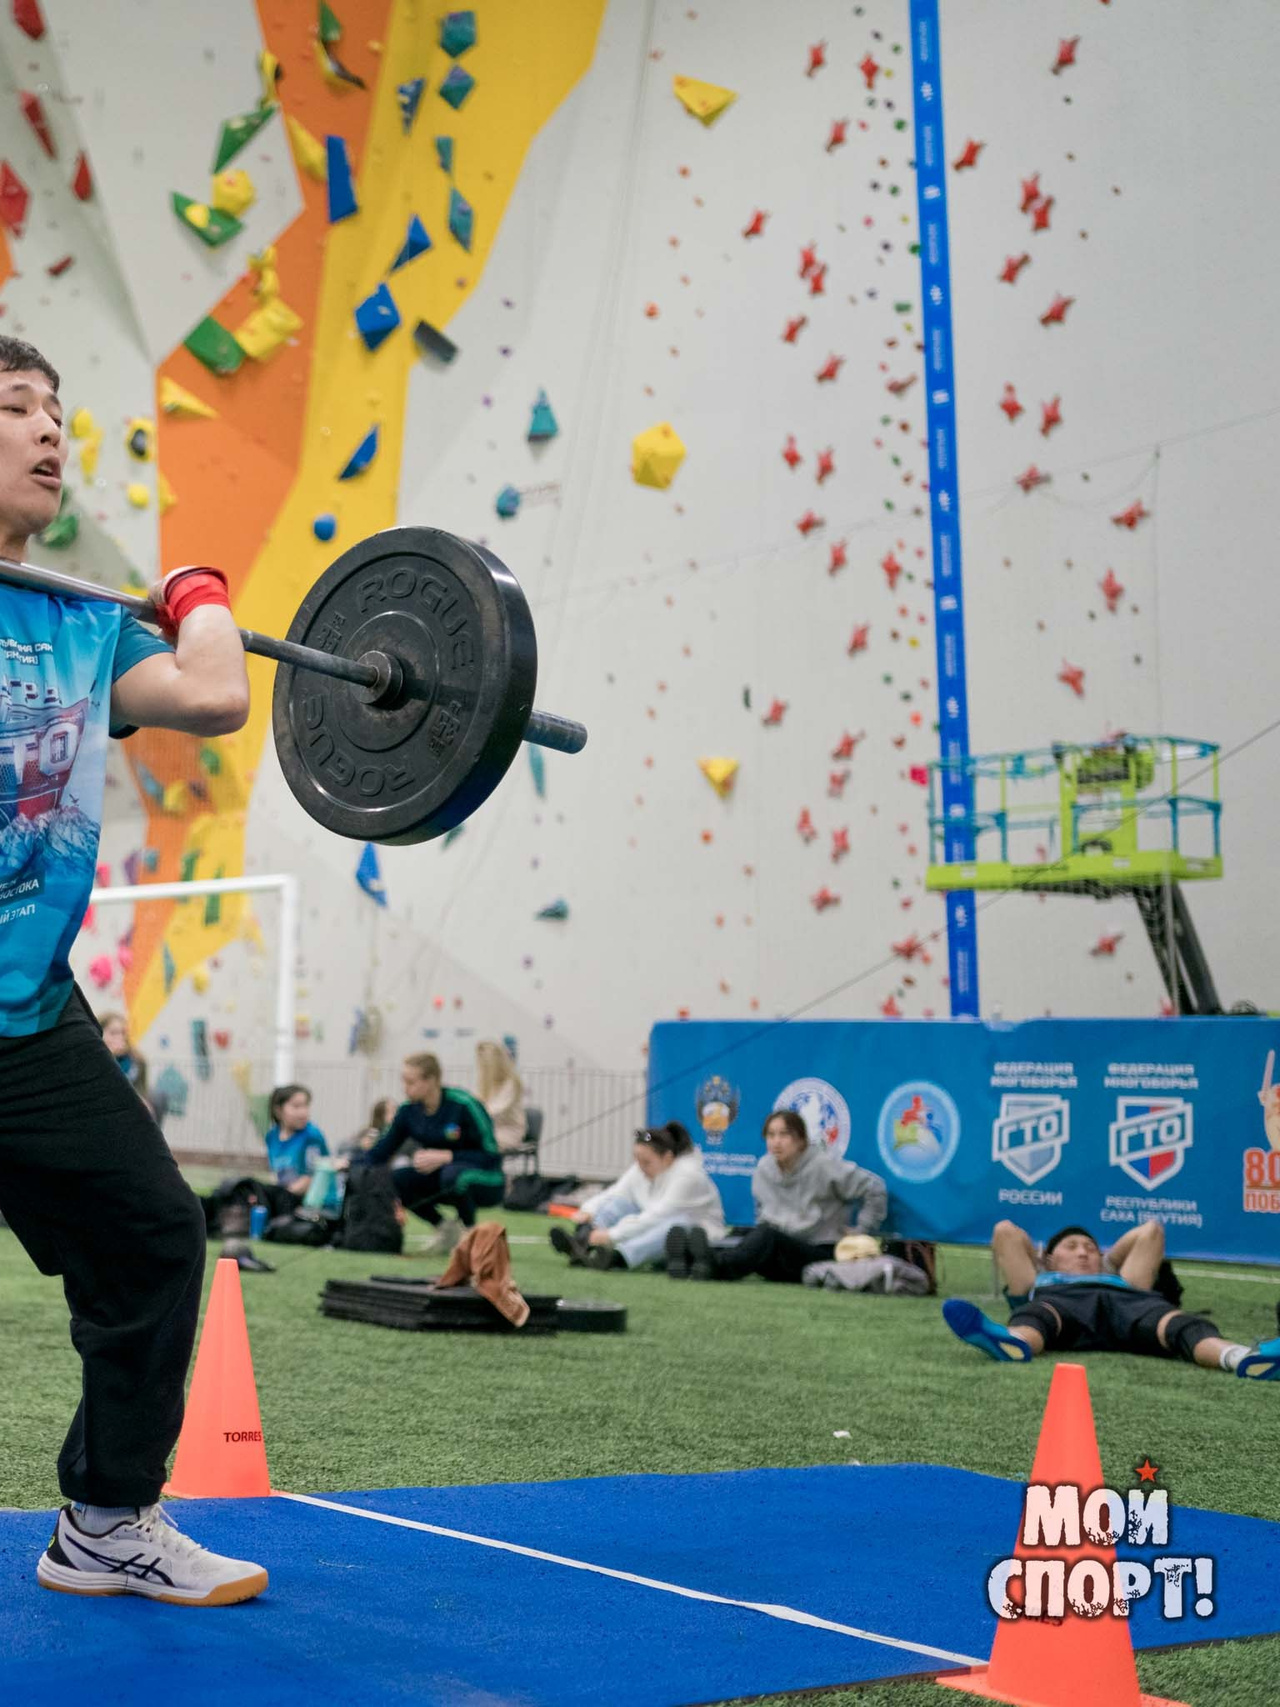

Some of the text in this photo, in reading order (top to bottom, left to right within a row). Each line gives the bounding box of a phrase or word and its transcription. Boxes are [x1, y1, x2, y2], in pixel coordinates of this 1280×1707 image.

[355, 567, 476, 671] ROGUE
[302, 693, 417, 798] ROGUE
[10, 902, 37, 922] ЭТАП
[1001, 1112, 1059, 1151] ГТО
[1120, 1115, 1182, 1155] ГТО
[998, 1188, 1063, 1206] РОССИИ
[1105, 1195, 1198, 1213] РЕСПУБЛИКИ
[1100, 1210, 1135, 1224] САХА
[223, 1431, 262, 1443] TORRES
